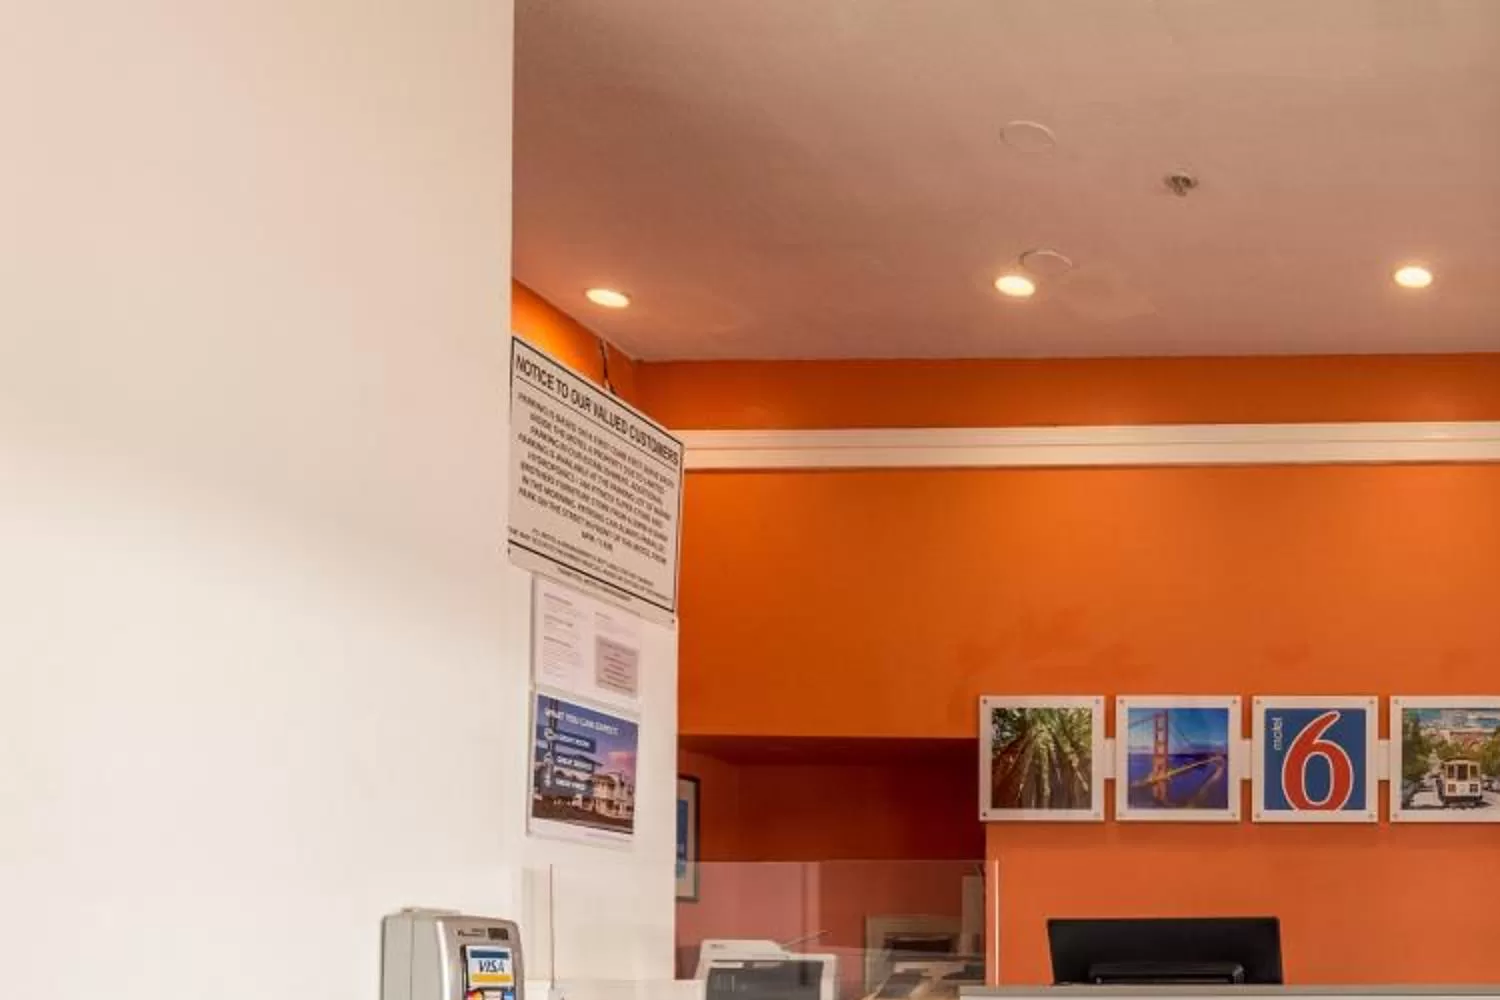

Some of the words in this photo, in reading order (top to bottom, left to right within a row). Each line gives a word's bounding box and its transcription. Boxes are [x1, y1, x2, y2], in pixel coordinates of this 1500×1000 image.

[515, 354, 556, 390] NOTICE
[556, 378, 569, 398] TO
[570, 388, 591, 413] OUR
[594, 400, 628, 435] VALUED
[629, 425, 679, 465] CUSTOMERS
[1272, 717, 1283, 751] motel
[1281, 710, 1354, 811] 6
[478, 960, 505, 972] VISA
